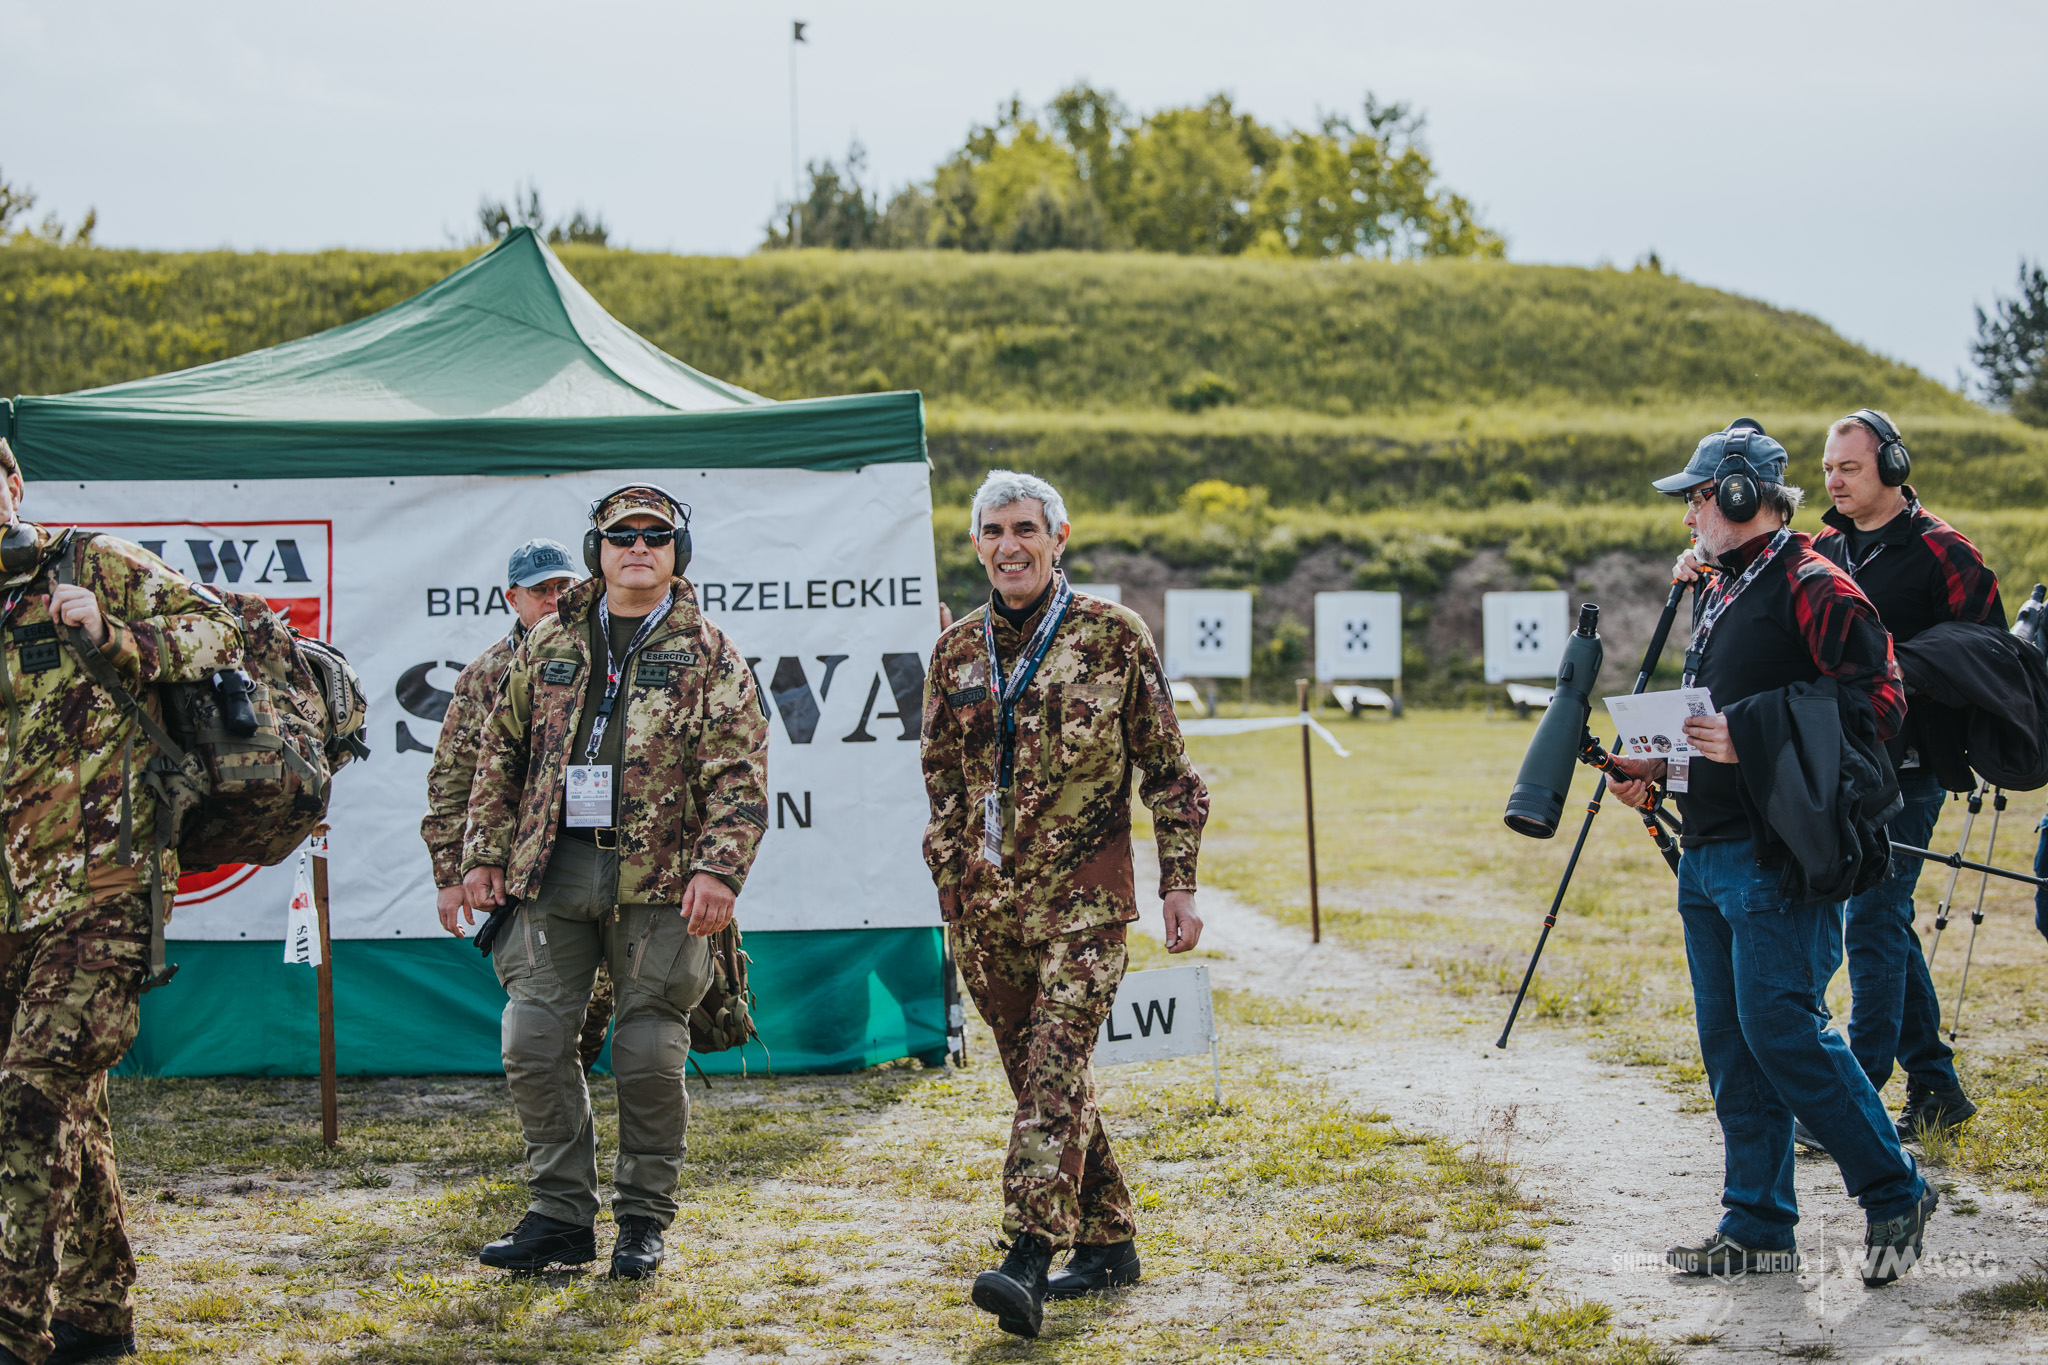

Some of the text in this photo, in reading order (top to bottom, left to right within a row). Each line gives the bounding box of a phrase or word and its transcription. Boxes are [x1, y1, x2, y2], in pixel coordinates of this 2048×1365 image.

[427, 576, 922, 617] BRA RZELECKIE
[646, 652, 691, 662] ESERCITO
